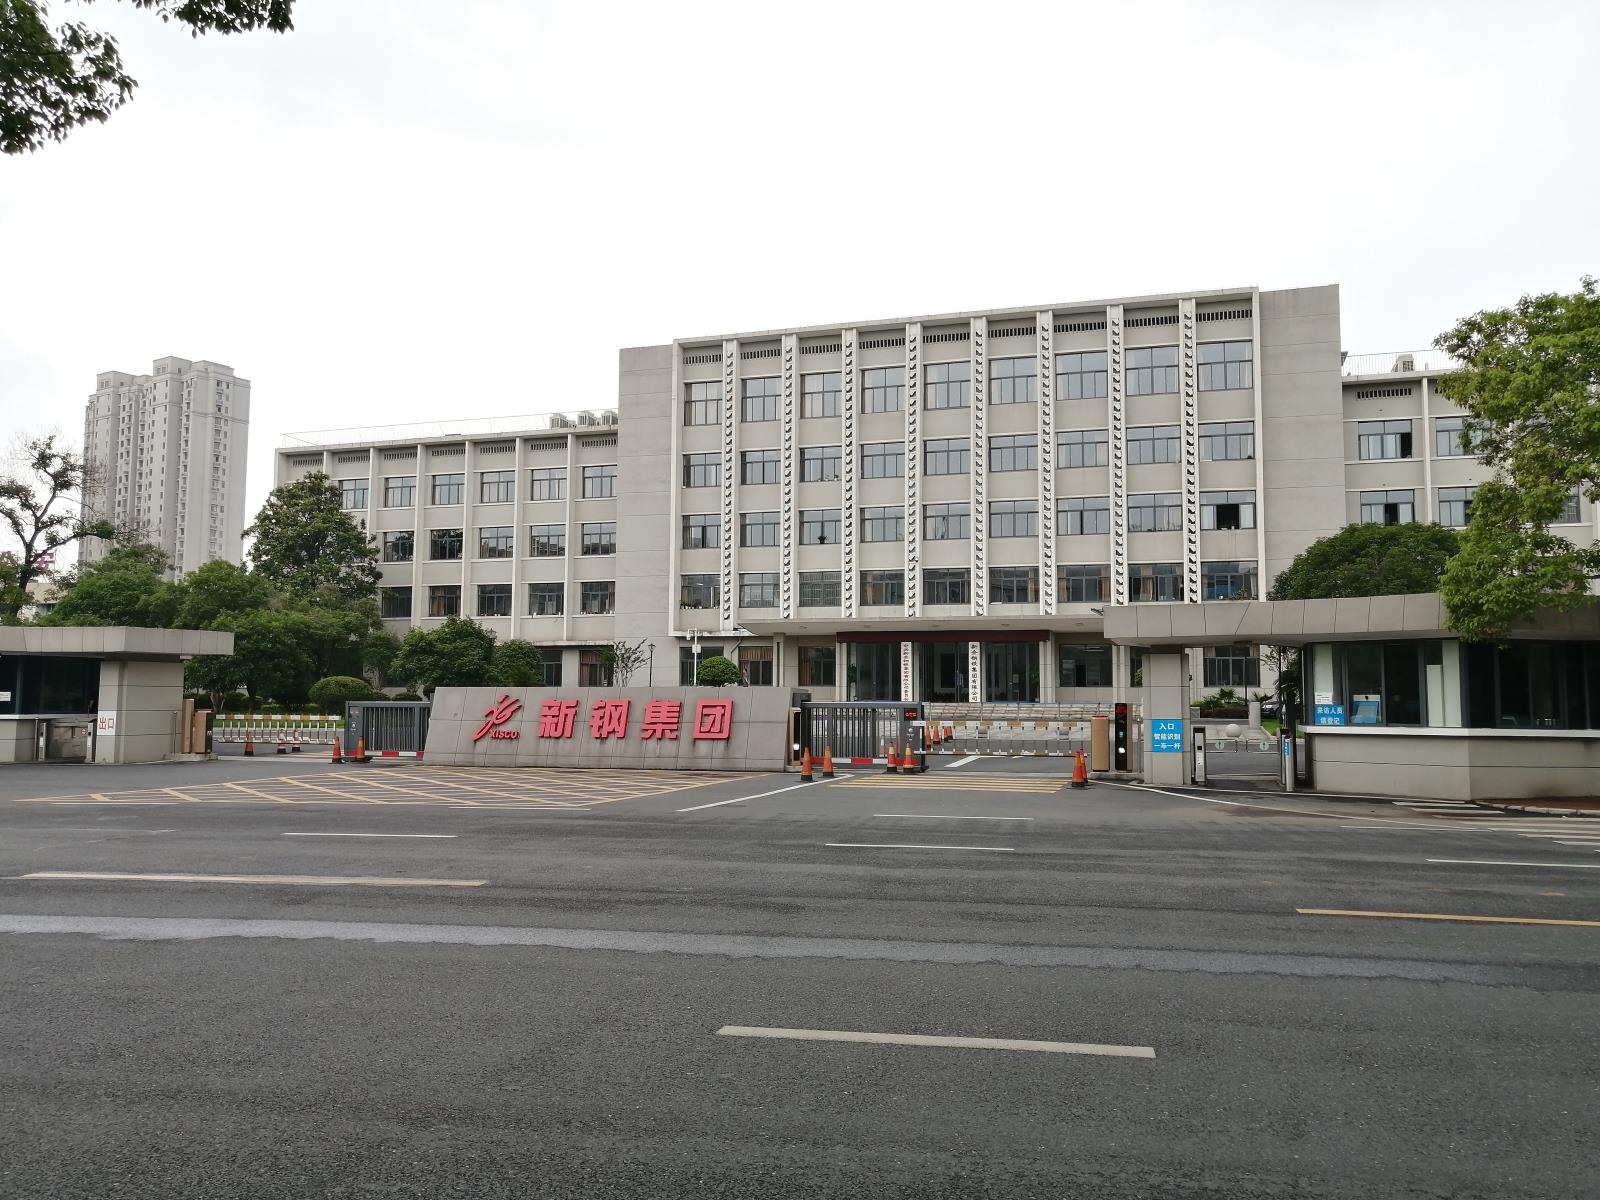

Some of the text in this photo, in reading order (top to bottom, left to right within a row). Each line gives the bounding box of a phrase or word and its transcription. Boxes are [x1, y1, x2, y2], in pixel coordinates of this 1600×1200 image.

[1317, 706, 1343, 714] 来访人员
[99, 716, 114, 730] 出口
[538, 699, 734, 740] 新钢集团
[1159, 722, 1175, 730] 入口
[490, 730, 518, 739] XISCO
[1154, 742, 1181, 750] 一车一杆
